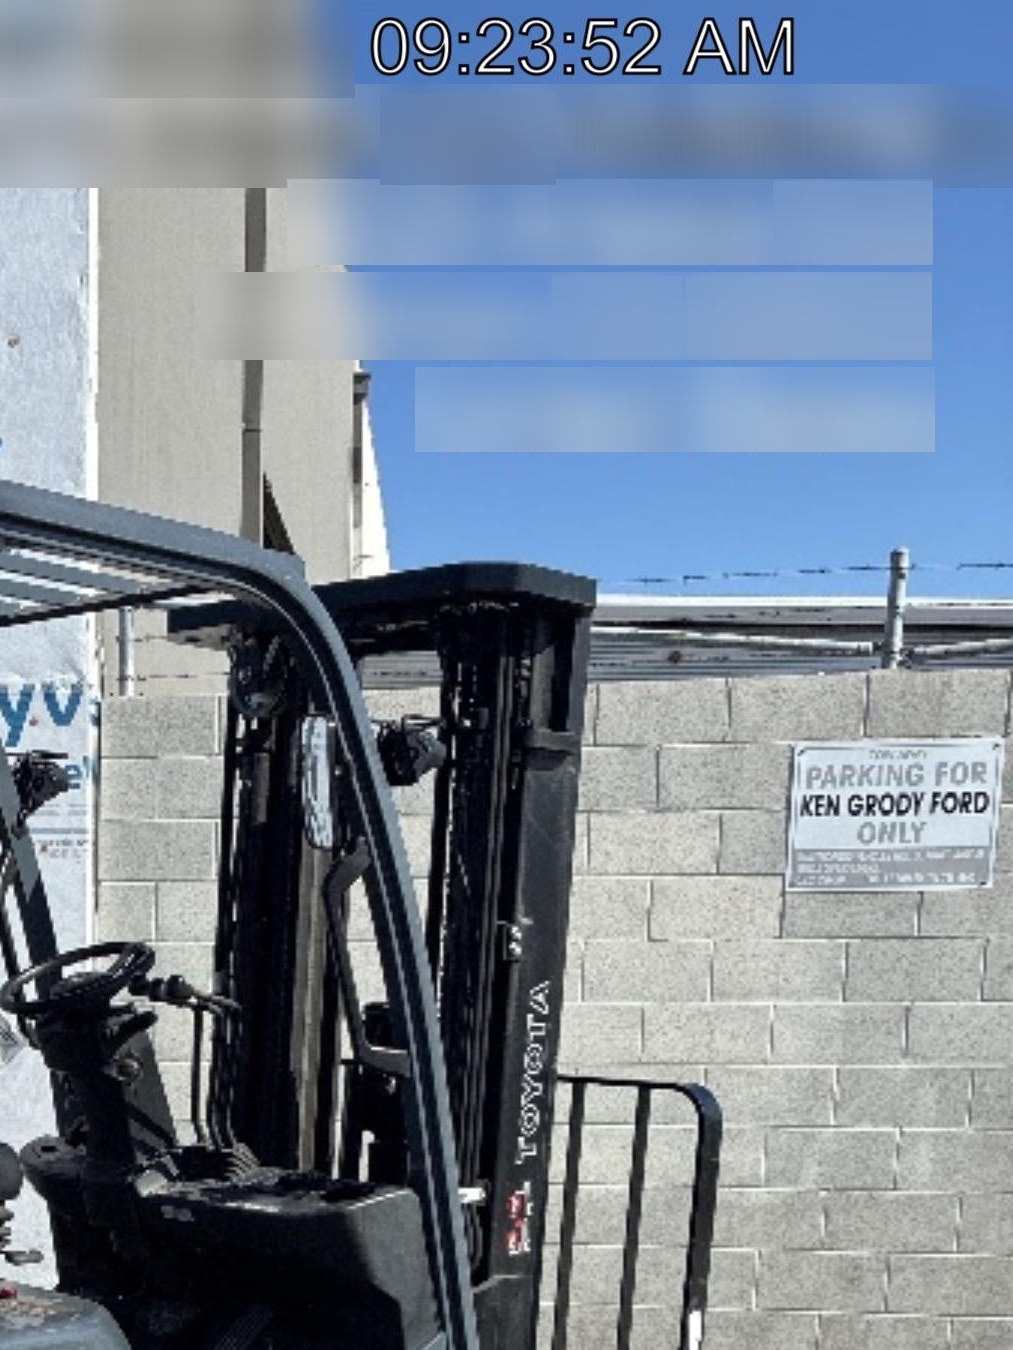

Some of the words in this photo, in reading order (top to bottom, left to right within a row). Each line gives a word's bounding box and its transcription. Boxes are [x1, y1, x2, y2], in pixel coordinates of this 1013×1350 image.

[805, 764, 925, 789] PARKING
[935, 762, 987, 785] FOR
[800, 794, 840, 817] KEN
[847, 792, 924, 817] GRODY
[929, 791, 990, 814] FORD
[856, 821, 927, 844] ONLY
[515, 980, 551, 1165] TOYOTA
